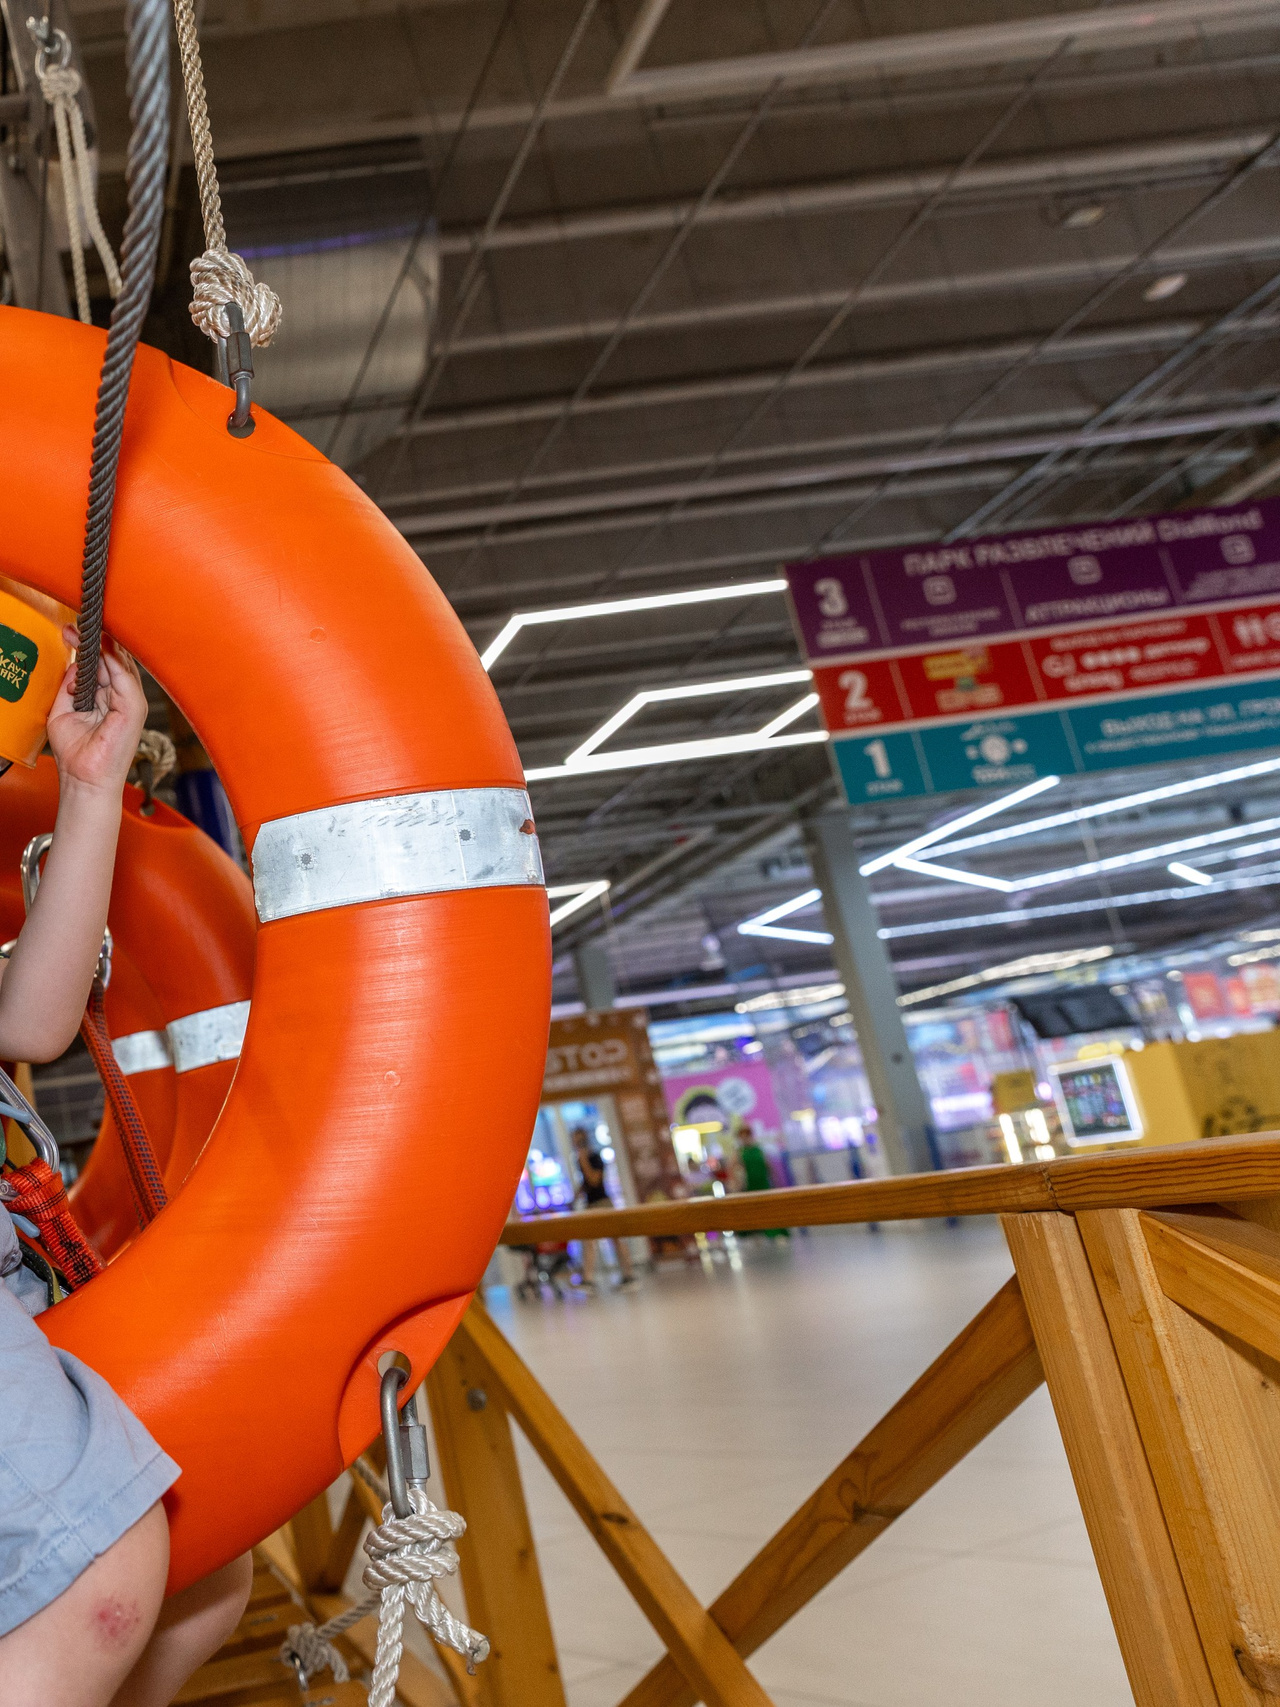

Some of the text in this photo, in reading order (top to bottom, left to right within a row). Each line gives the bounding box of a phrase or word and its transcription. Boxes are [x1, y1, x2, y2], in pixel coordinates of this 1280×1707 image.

[903, 549, 972, 576] ПАРК
[975, 521, 1155, 567] РАЗВЛЕЧЕНИЙ
[814, 577, 848, 616] 3
[838, 669, 874, 710] 2
[864, 739, 891, 778] 1
